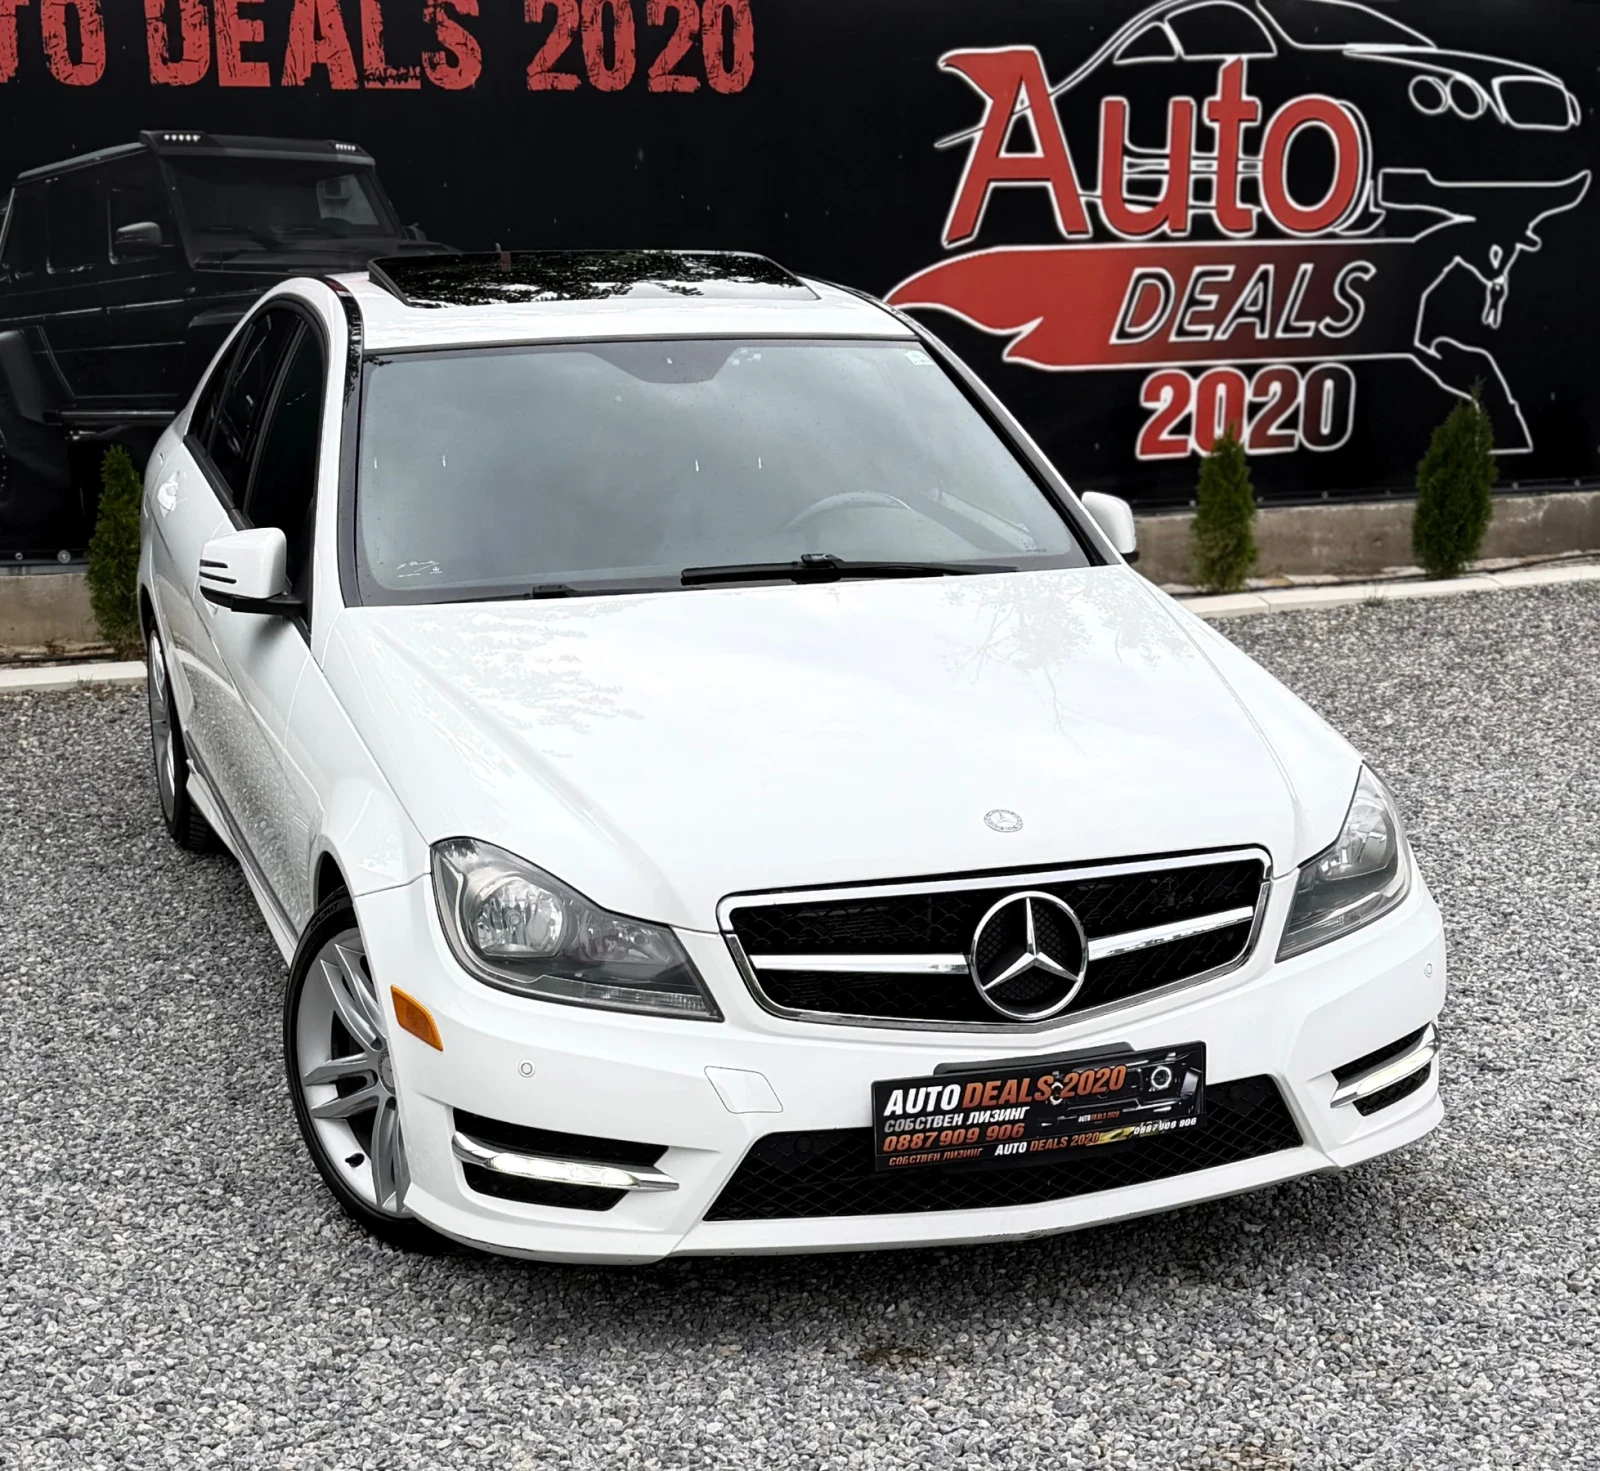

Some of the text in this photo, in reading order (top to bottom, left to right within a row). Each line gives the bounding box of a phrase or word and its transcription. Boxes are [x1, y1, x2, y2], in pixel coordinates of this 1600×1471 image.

[144, 0, 482, 91] DEALS
[525, 0, 755, 94] 2020
[938, 45, 1363, 248] Auto
[1108, 261, 1376, 345] DEALS
[1135, 362, 1356, 460] 2020
[883, 1065, 1127, 1117] AUTO DEALS 2020
[884, 1106, 1030, 1133] СОБСТВЕН ЛИЗИНГ
[985, 1123, 1025, 1142] 906
[994, 1132, 1099, 1156] AUTO DEALS 2020
[889, 1154, 940, 1166] СОБСТВЕН
